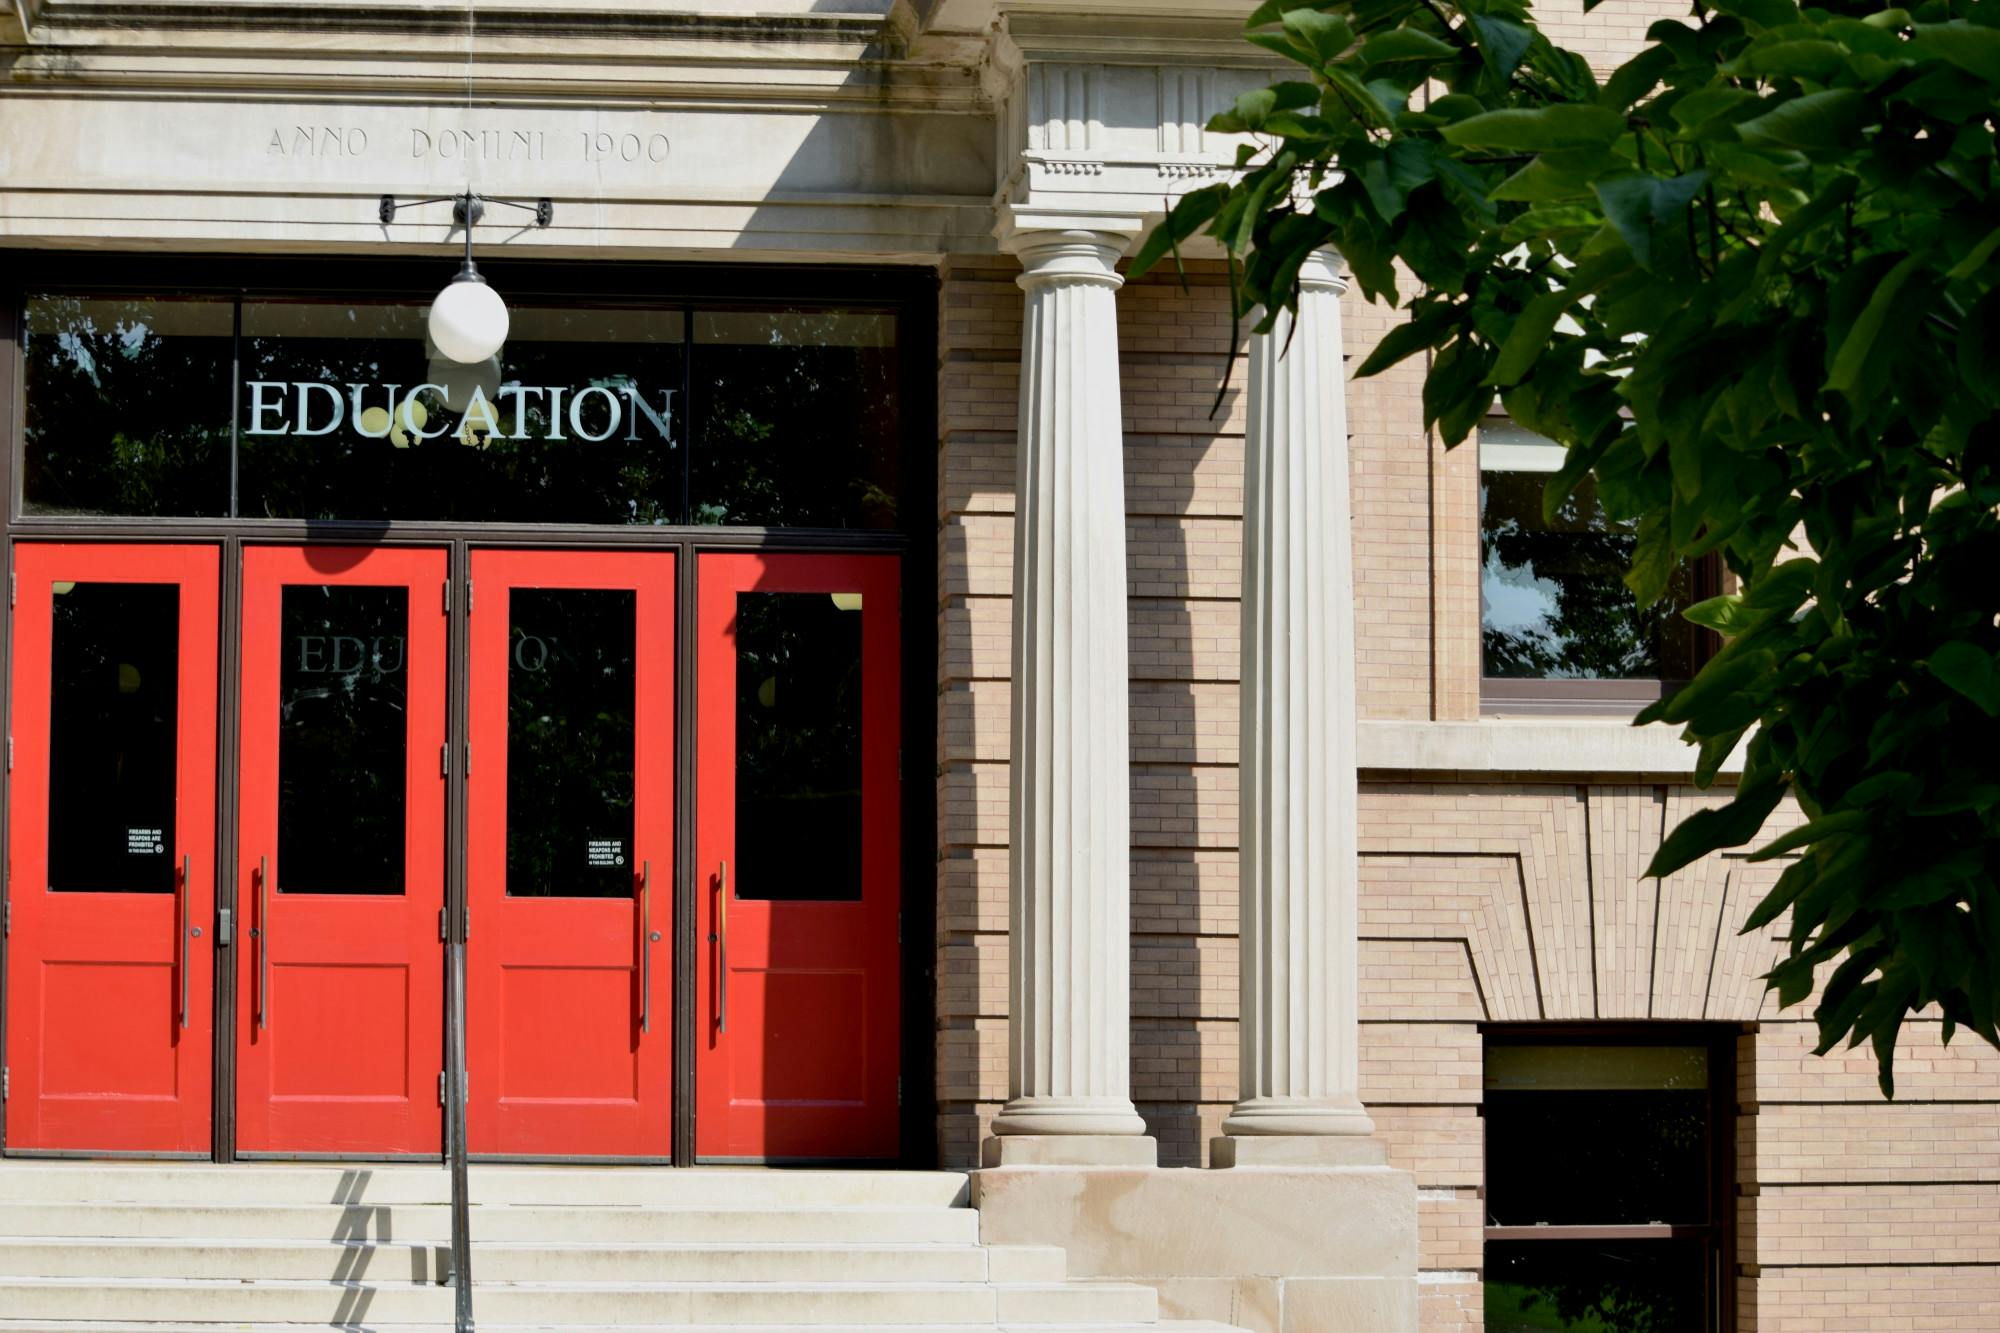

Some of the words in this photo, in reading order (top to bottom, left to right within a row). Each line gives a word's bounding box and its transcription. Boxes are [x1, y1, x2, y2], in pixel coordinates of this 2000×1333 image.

[266, 125, 368, 157] ANNO
[411, 128, 545, 160] DOMINI
[581, 132, 671, 163] 1900
[245, 380, 678, 442] EDUCATION
